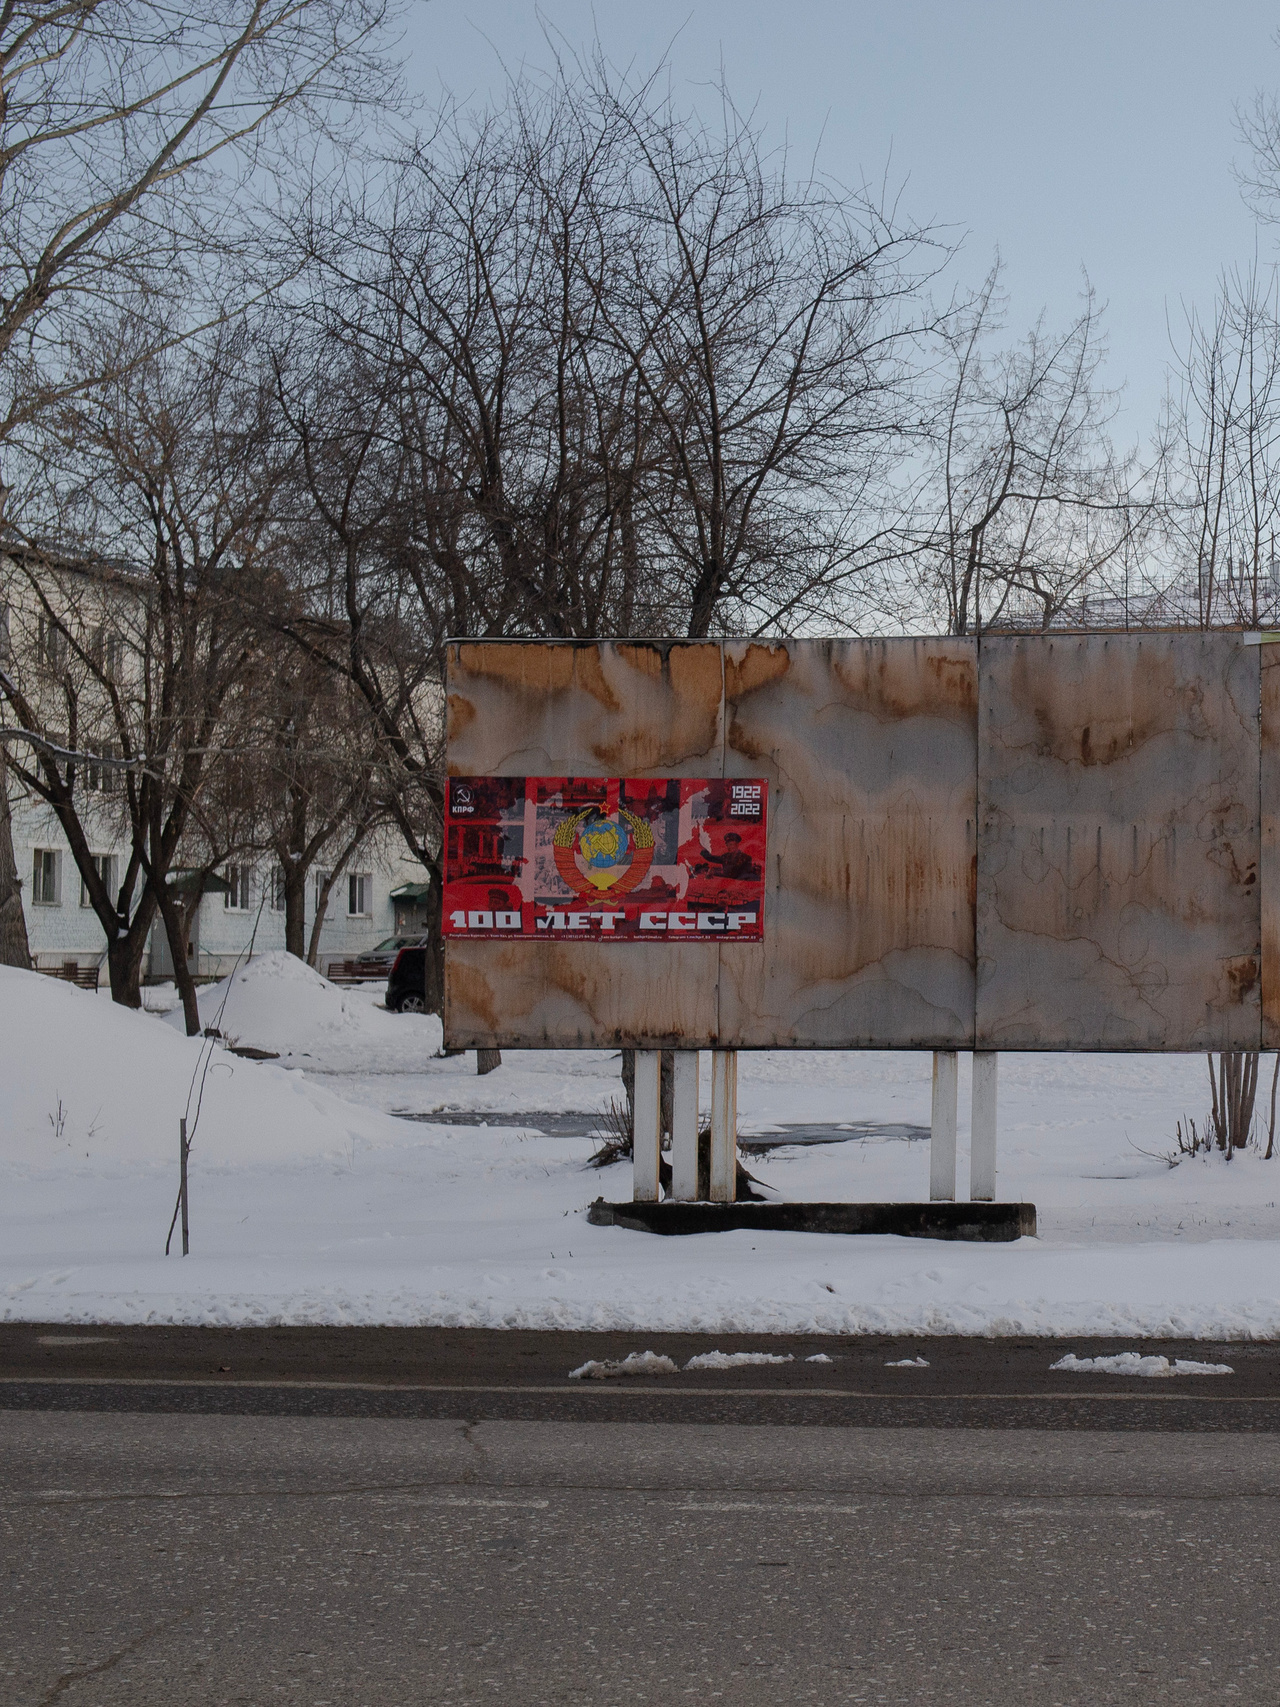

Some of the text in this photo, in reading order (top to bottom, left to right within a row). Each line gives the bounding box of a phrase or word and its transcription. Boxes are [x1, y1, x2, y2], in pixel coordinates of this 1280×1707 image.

[731, 785, 761, 799] 1922
[452, 805, 475, 813] КПРФ
[730, 803, 760, 815] 2022
[450, 910, 757, 930] 100 ЛЕТ СССР
